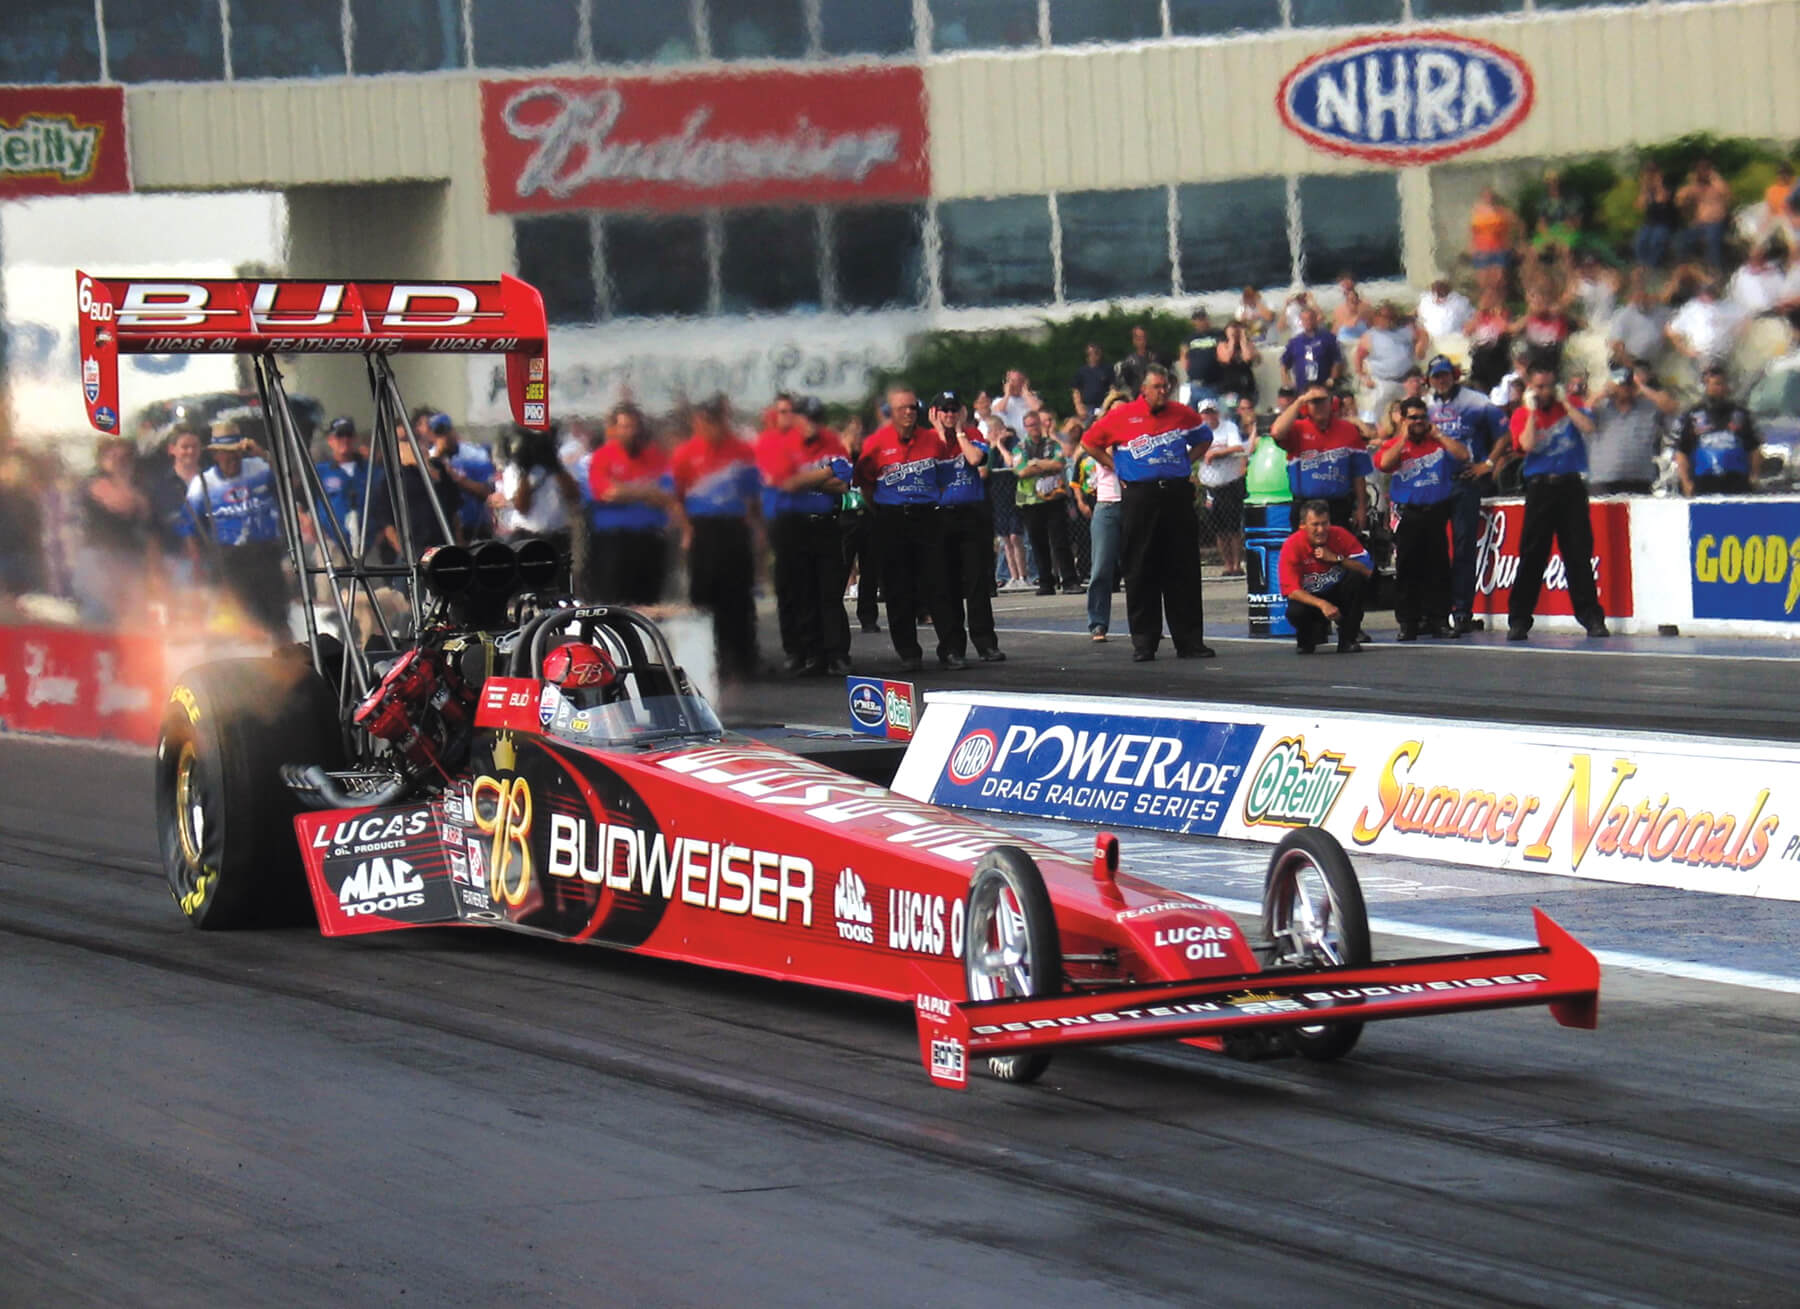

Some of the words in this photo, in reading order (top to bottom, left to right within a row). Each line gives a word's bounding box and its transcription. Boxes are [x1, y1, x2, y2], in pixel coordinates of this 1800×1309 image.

[1317, 54, 1496, 141] NHRA
[0, 126, 90, 170] eilly
[78, 277, 92, 313] 6
[89, 302, 113, 321] BUD
[145, 337, 207, 351] LUCAS
[209, 337, 237, 351] OIL
[429, 337, 488, 351] LUCAS
[490, 337, 520, 351] OIL
[524, 404, 545, 420] PRO
[575, 607, 609, 618] BUD
[509, 691, 530, 707] BUD
[954, 739, 993, 776] NHRA
[981, 778, 1040, 801] DRAG
[1046, 785, 1129, 811] RACING
[1134, 793, 1219, 821] SERIES
[1247, 747, 1345, 826] O'Reilly
[1352, 740, 1540, 846] Summer
[1523, 753, 1780, 871] Nationals
[313, 811, 429, 848] LUCAS
[354, 839, 406, 854] PRODUCTS
[339, 857, 424, 904] MAC
[549, 813, 814, 927] BUDWEISER
[340, 892, 425, 917] TOOLS
[834, 867, 873, 924] MAC
[836, 921, 875, 944] TOOLS
[888, 888, 945, 955] LUCAS
[1154, 926, 1233, 946] LUCAS
[1186, 942, 1227, 961] OIL
[1303, 973, 1549, 1001] BUDWEISER
[971, 1002, 1222, 1035] BERNSTEIN
